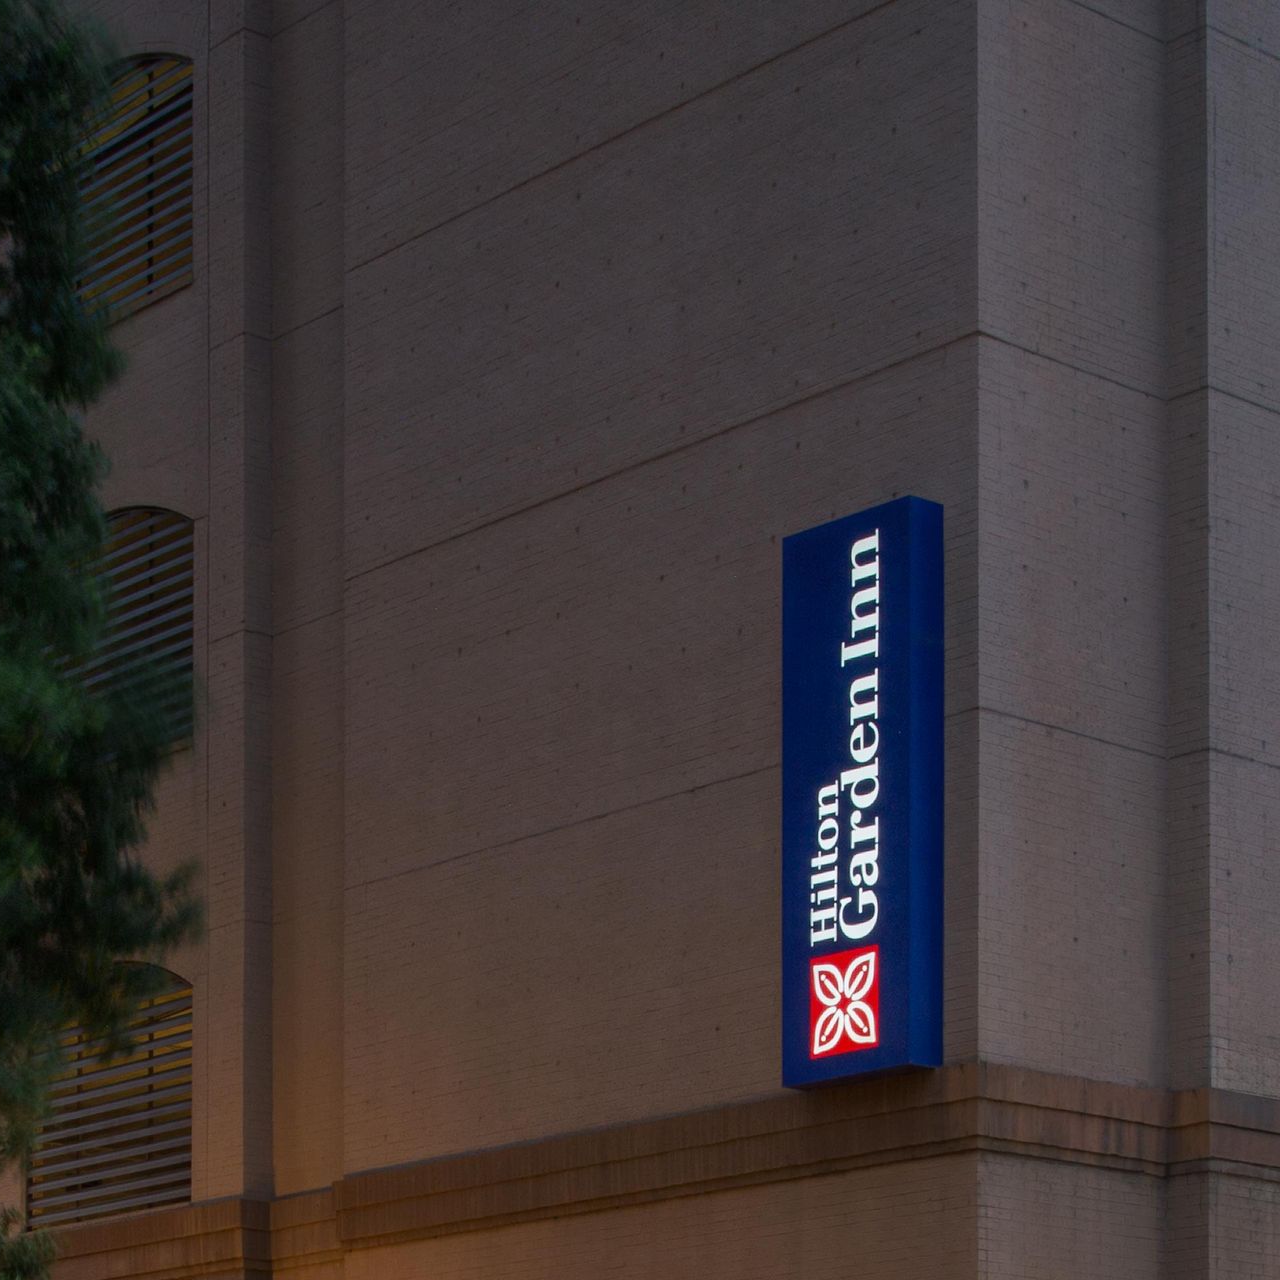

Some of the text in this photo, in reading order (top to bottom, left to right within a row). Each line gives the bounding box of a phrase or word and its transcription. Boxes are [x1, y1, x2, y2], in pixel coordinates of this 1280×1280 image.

[811, 780, 838, 947] Hilton
[839, 528, 879, 940] Garden Inn
